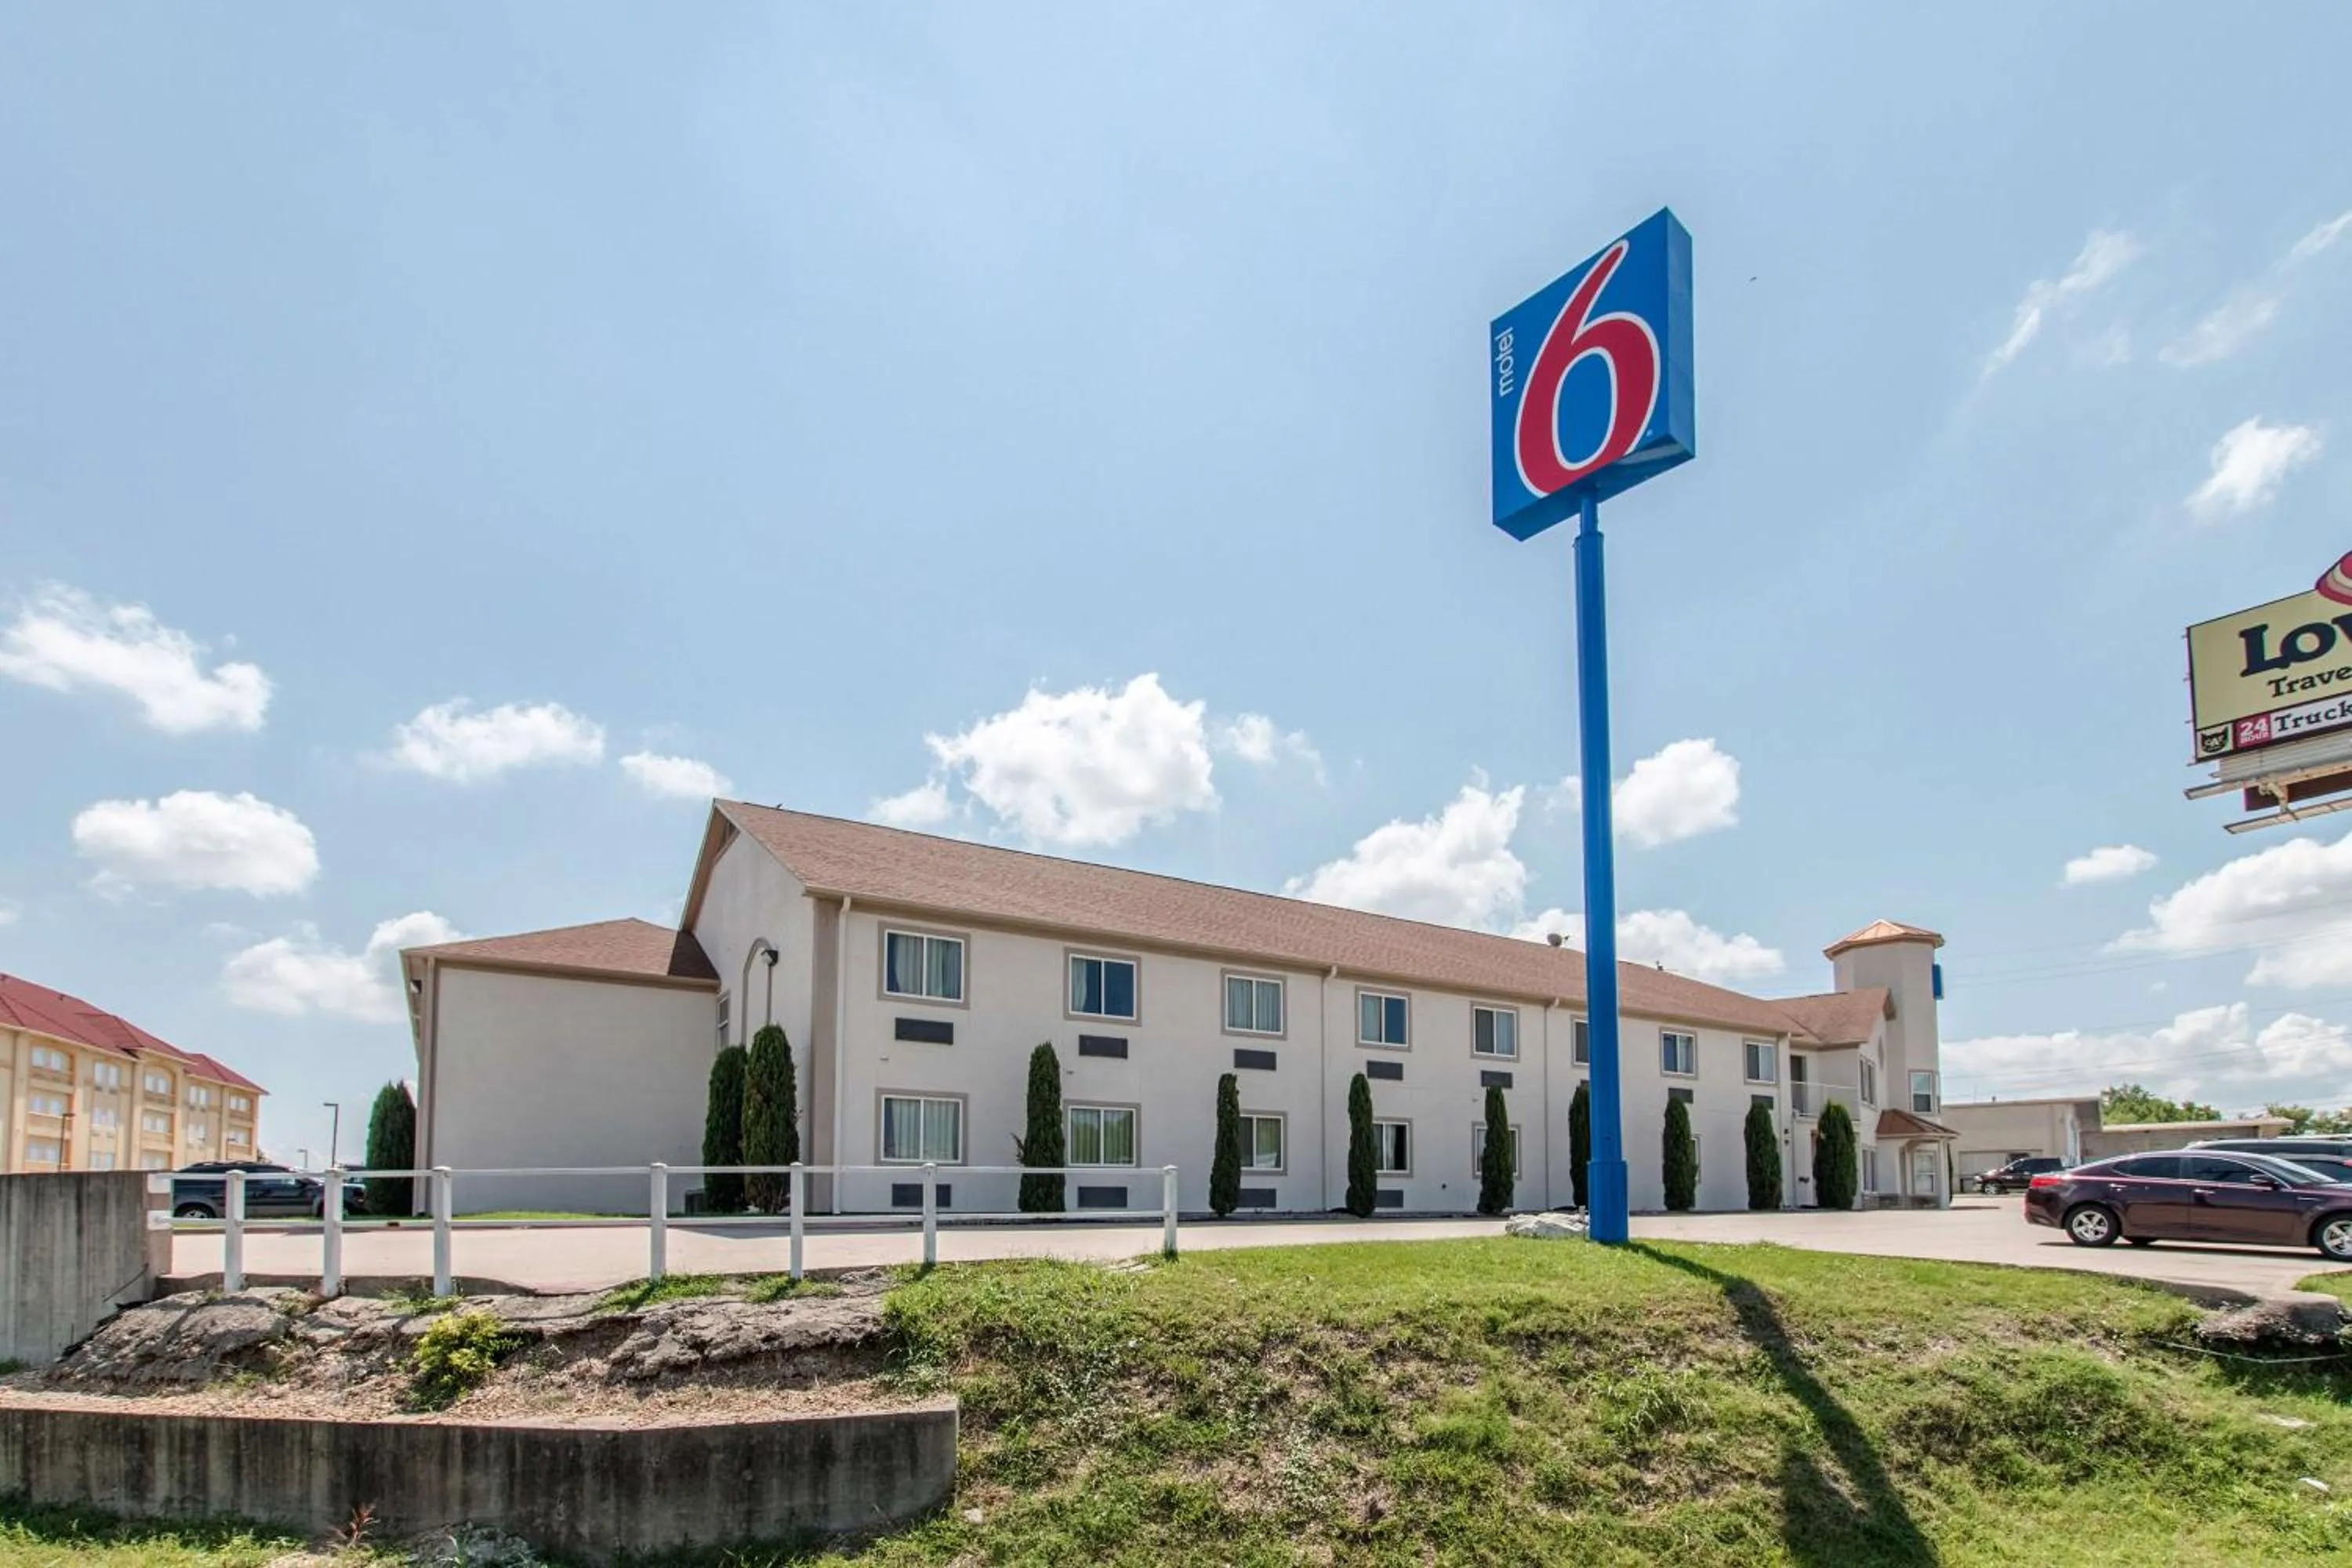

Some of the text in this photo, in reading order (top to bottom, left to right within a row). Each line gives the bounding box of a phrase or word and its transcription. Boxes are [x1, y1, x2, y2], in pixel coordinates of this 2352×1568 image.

[1494, 326, 1514, 397] motel
[1514, 238, 1660, 499] 6
[2240, 718, 2267, 737] 24
